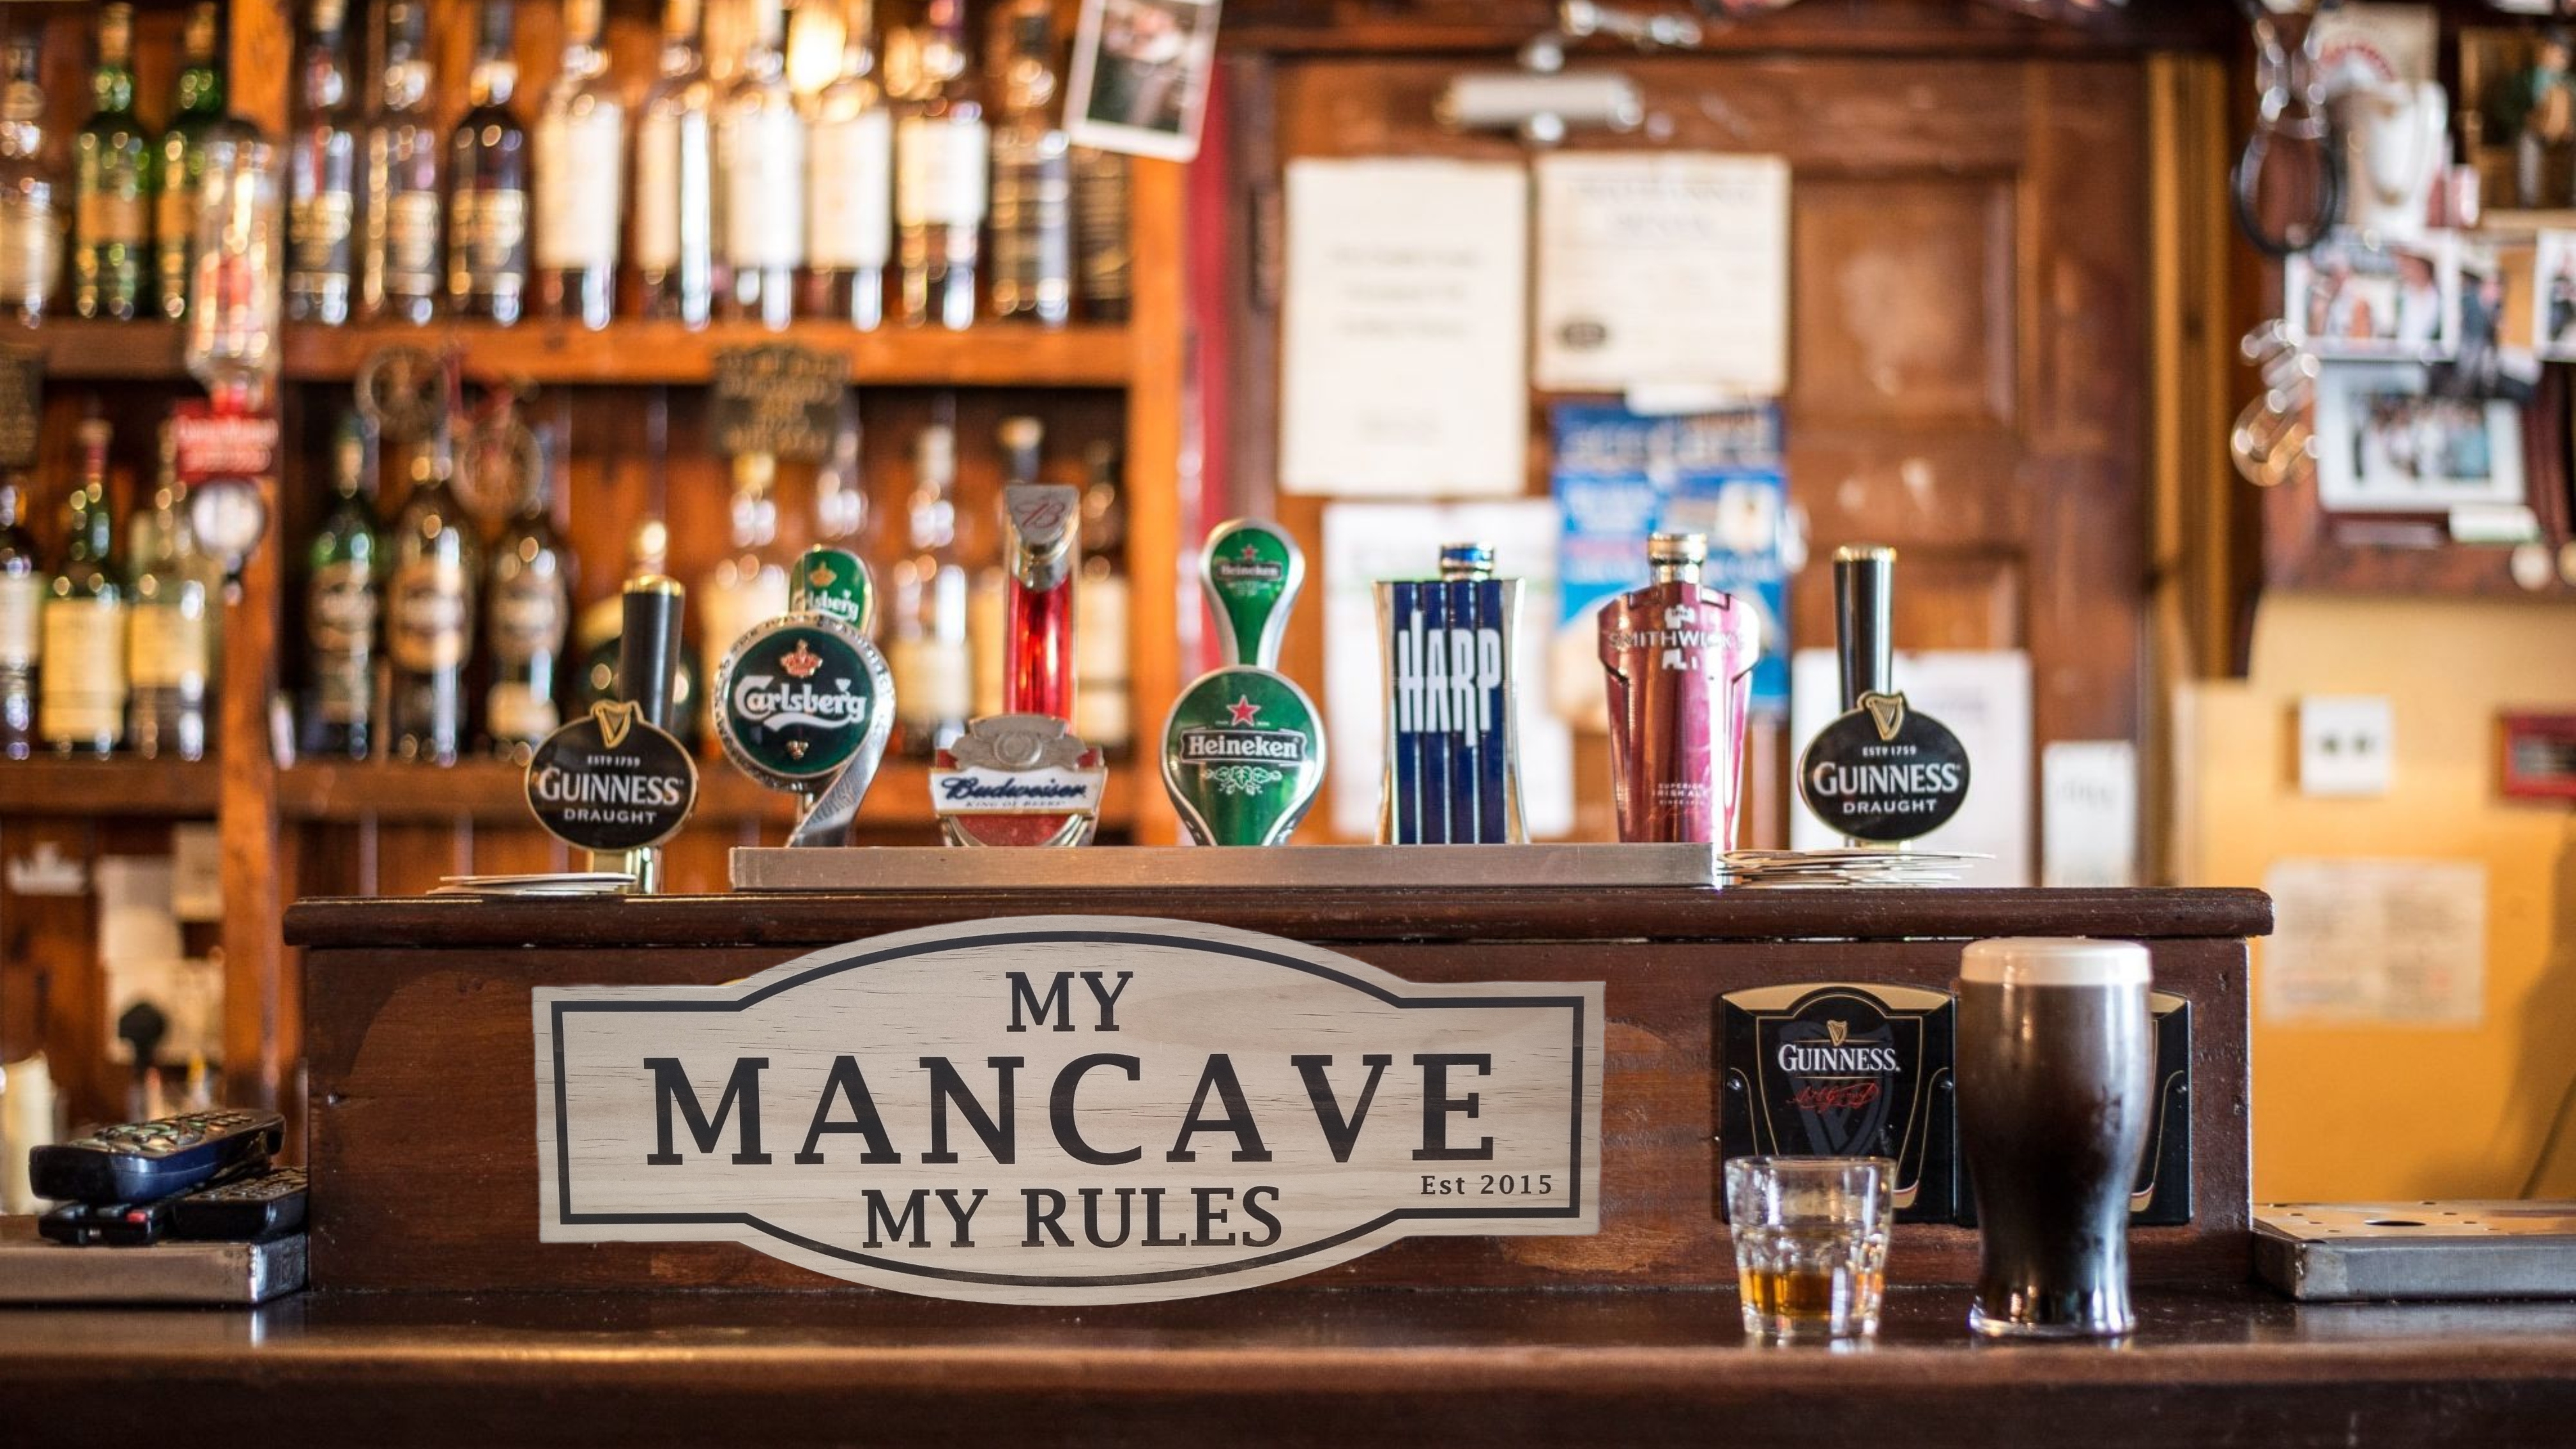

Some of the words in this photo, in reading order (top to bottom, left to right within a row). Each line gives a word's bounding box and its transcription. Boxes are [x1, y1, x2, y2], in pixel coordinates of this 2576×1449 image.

[1399, 610, 1501, 747] HARP
[735, 675, 867, 730] Carlsberg
[1188, 735, 1298, 758] Heineken
[1891, 745, 1917, 755] 1759
[539, 767, 680, 805] GUINNESS
[941, 778, 1086, 799] Budweiser
[1813, 762, 1959, 795] GUINNESS
[564, 808, 656, 824] DRAUGHT
[1843, 799, 1937, 814] DRAUGHT
[1006, 971, 1133, 1032] MY
[1778, 1044, 1897, 1072] GUINNESS
[643, 1053, 1494, 1166] MANCAVE
[1420, 1176, 1465, 1195] Est
[1480, 1175, 1552, 1195] 2015
[862, 1188, 988, 1248] MY
[1020, 1186, 1282, 1248] RULES
